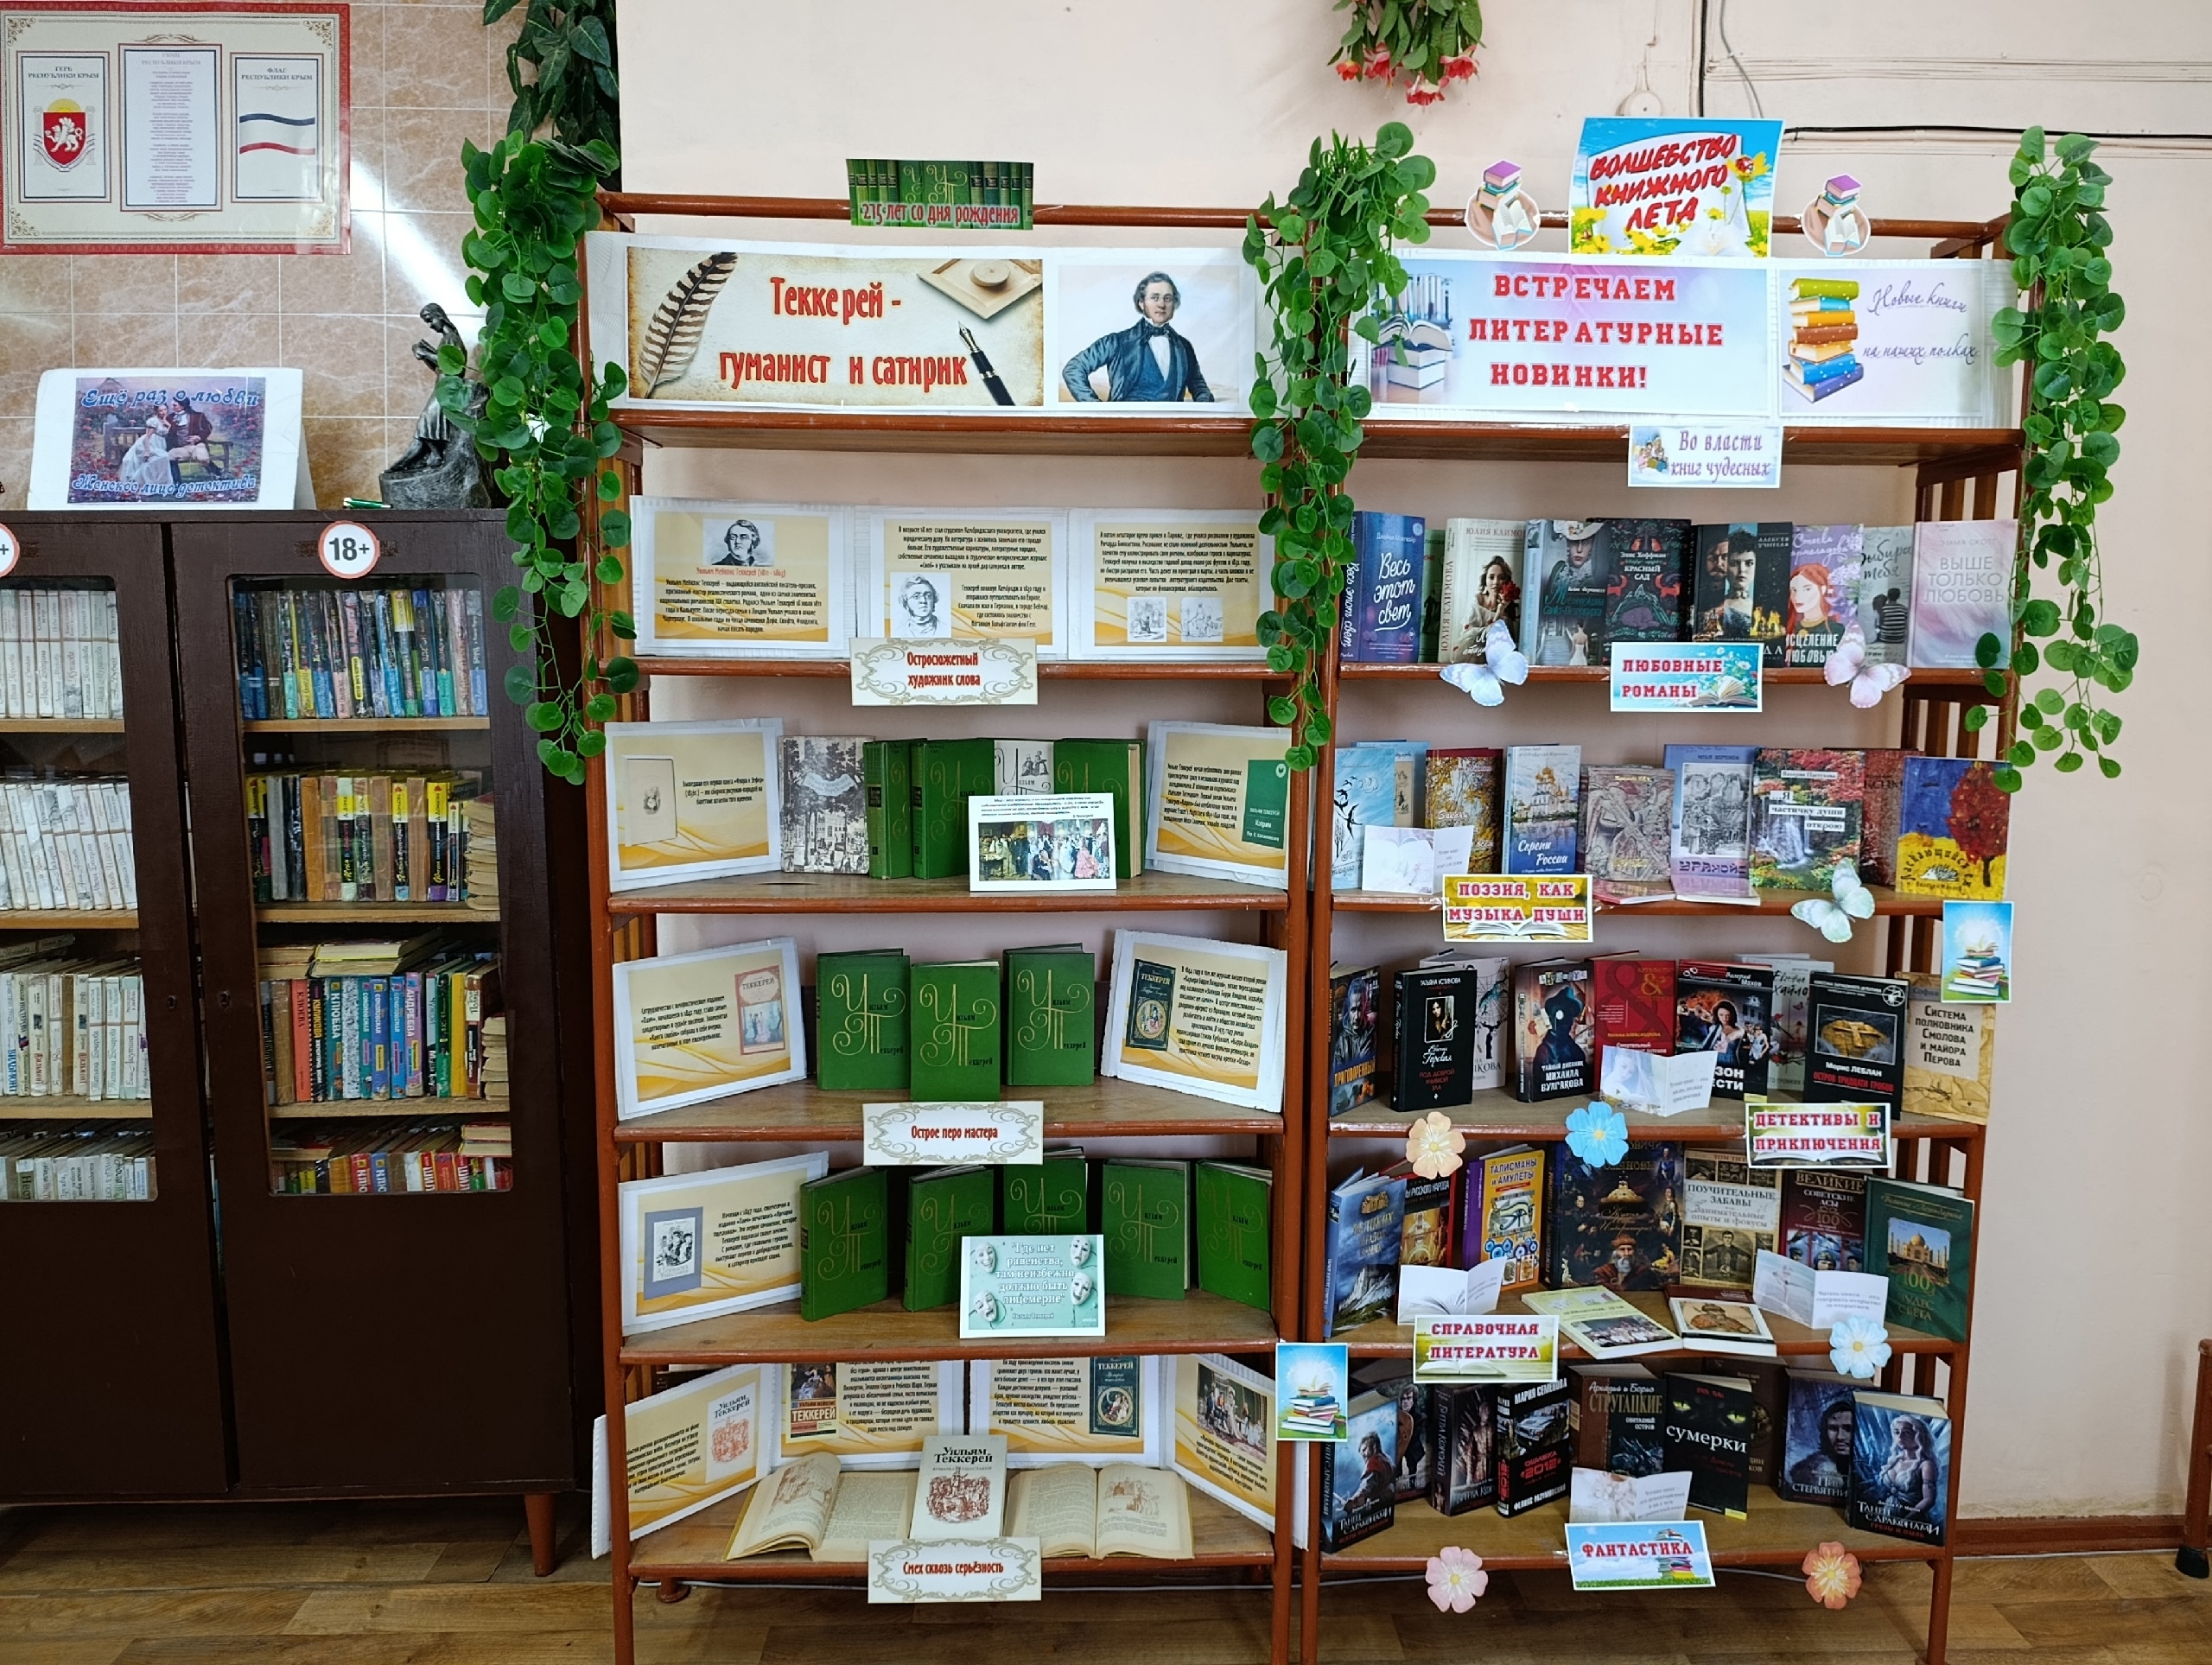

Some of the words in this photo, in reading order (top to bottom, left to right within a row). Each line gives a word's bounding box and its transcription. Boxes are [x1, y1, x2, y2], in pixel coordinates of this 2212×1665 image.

[1589, 133, 1738, 181] ВОЛШЕБСТВО
[1594, 163, 1728, 210] КНИЖНОГО
[886, 204, 906, 220] лет
[912, 205, 923, 220] со
[928, 206, 950, 226] дня
[956, 206, 1018, 226] рождения
[1625, 197, 1700, 232] ЛЕТА
[1494, 275, 1675, 302] ВСТРЕЧАЕМ
[770, 276, 884, 325] Теккерей
[1867, 280, 1924, 316] Новые
[1926, 282, 1967, 313] книги
[1469, 318, 1724, 346] ЛИТЕРАТУРНЫЕ
[1863, 348, 1880, 357] на
[1884, 347, 1926, 365] наших
[1929, 334, 1978, 365] полках
[719, 351, 830, 392] гуманист
[850, 356, 863, 384] и
[873, 353, 967, 392] сатирик
[1490, 362, 1648, 390] НОВИНКИ!
[81, 389, 128, 408] Ещё
[132, 388, 167, 409] раз
[174, 390, 188, 402] о
[191, 387, 259, 407] любви
[1679, 429, 1697, 451] Во
[1705, 435, 1763, 452] власти
[1671, 461, 1702, 476] книг
[1707, 456, 1770, 484] чудесных
[71, 473, 137, 492] Женское
[141, 480, 175, 497] лицо
[175, 476, 256, 498] детектива
[328, 537, 370, 561] 18+
[1379, 552, 1411, 580] Весь
[1864, 559, 1900, 581] тебя
[1940, 556, 1993, 570] ВЫШЕ
[1346, 562, 1360, 585] Весь
[1928, 573, 2003, 587] ТОЛЬКО
[1374, 579, 1415, 604] этот
[1442, 560, 1454, 618] КЛИМОВА
[1924, 589, 2004, 603] ЛЮБОВЬ
[1344, 587, 1354, 618] этот
[1378, 600, 1412, 625] свет
[1343, 620, 1357, 647] свет
[1440, 619, 1450, 651] ЮЛИЯ
[907, 651, 978, 668] Остросюжетный
[1623, 659, 1722, 672] ЛЮБОВНЫЕ
[908, 674, 954, 690] художник
[956, 674, 981, 686] слова
[1622, 685, 1697, 698] РОМАНЫ
[1772, 791, 1791, 800] ...Я
[1771, 806, 1814, 816] частичку
[1816, 806, 1843, 817] души
[1806, 822, 1843, 832] открою
[1517, 840, 1552, 854] Скрепы
[1536, 853, 1568, 866] России
[1540, 883, 1574, 897] КАК
[1448, 908, 1524, 921] МУЗЫКА
[742, 978, 774, 989] ТЕККЕРЕЙ
[1141, 973, 1171, 985] ТЕККЕРЕЙ
[1726, 972, 1751, 981] Валерий
[297, 991, 306, 1027] КЛЮЕВА
[331, 993, 340, 1039] КЛЮЕВА
[406, 988, 415, 1037] АНДРЕЕВА
[1923, 1005, 1967, 1021] Система
[313, 999, 323, 1039] КУЛИКОВА
[1915, 1017, 1974, 1033] полковника
[1923, 1028, 1967, 1045] Смолова
[1920, 1042, 1926, 1051] и
[1929, 1044, 1967, 1057] майора
[1541, 1063, 1560, 1072] ТАЙНЫЙ
[1923, 1052, 1961, 1067] Перова
[1334, 1059, 1376, 1087] ПРИГОВОРЕННЫЙ
[1433, 1068, 1455, 1077] ДОБРОЙ
[1545, 1070, 1580, 1080] МИХАИЛА
[1814, 1071, 1836, 1083] ОСТРОВ
[1826, 1061, 1849, 1072] Морис
[1851, 1066, 1882, 1077] ЛЕБЛАН
[1541, 1078, 1584, 1092] БУЛГАКОВА
[912, 1125, 940, 1141] Острое
[942, 1128, 962, 1141] перо
[964, 1127, 998, 1141] мастера
[1490, 1158, 1537, 1175] ТАЛИСМАНЫ
[1497, 1171, 1535, 1185] АМУЛЕТЫ
[1796, 1172, 1865, 1193] ВЕЛИКИЕ
[1688, 1183, 1776, 1201] ПОУЧИТЕЛЬНЫЕ
[1803, 1189, 1856, 1203] СОВЕТСКИЕ
[1710, 1196, 1751, 1208] ЗАБАВЫ
[1819, 1198, 1839, 1208] АСЫ
[1691, 1212, 1720, 1223] опыты
[1732, 1216, 1768, 1229] фокусы
[1693, 1204, 1765, 1221] Занимательные
[1817, 1211, 1840, 1225] 100
[1038, 1243, 1055, 1252] нет
[1007, 1257, 1063, 1268] равенства,
[1018, 1268, 1074, 1278] неизбежно
[999, 1282, 1039, 1293] должно
[1042, 1281, 1068, 1290] быть
[1003, 1293, 1065, 1306] лицемерие"
[1432, 1323, 1539, 1335] СПРАВОЧНАЯ
[1515, 1389, 1536, 1405] МАРИЯ
[1537, 1378, 1567, 1396] СЕМЕНОВА
[713, 1398, 751, 1420] Теккерей
[719, 1394, 747, 1409] Уильям
[1589, 1395, 1663, 1415] СТРУГАЦКИЕ
[792, 1408, 836, 1420] ТЕККЕРЕЙ
[1667, 1426, 1747, 1454] сумерки
[934, 1453, 993, 1465] Теккерей
[943, 1446, 987, 1456] Уильям
[1524, 1451, 1558, 1466] ОШИБКА
[1514, 1496, 1533, 1510] ФЕЛИКС
[1857, 1500, 1891, 1515] ТАНЕЦ
[903, 1561, 924, 1575] Смех
[925, 1562, 952, 1574] сквозь
[956, 1561, 1003, 1577] серьёзность
